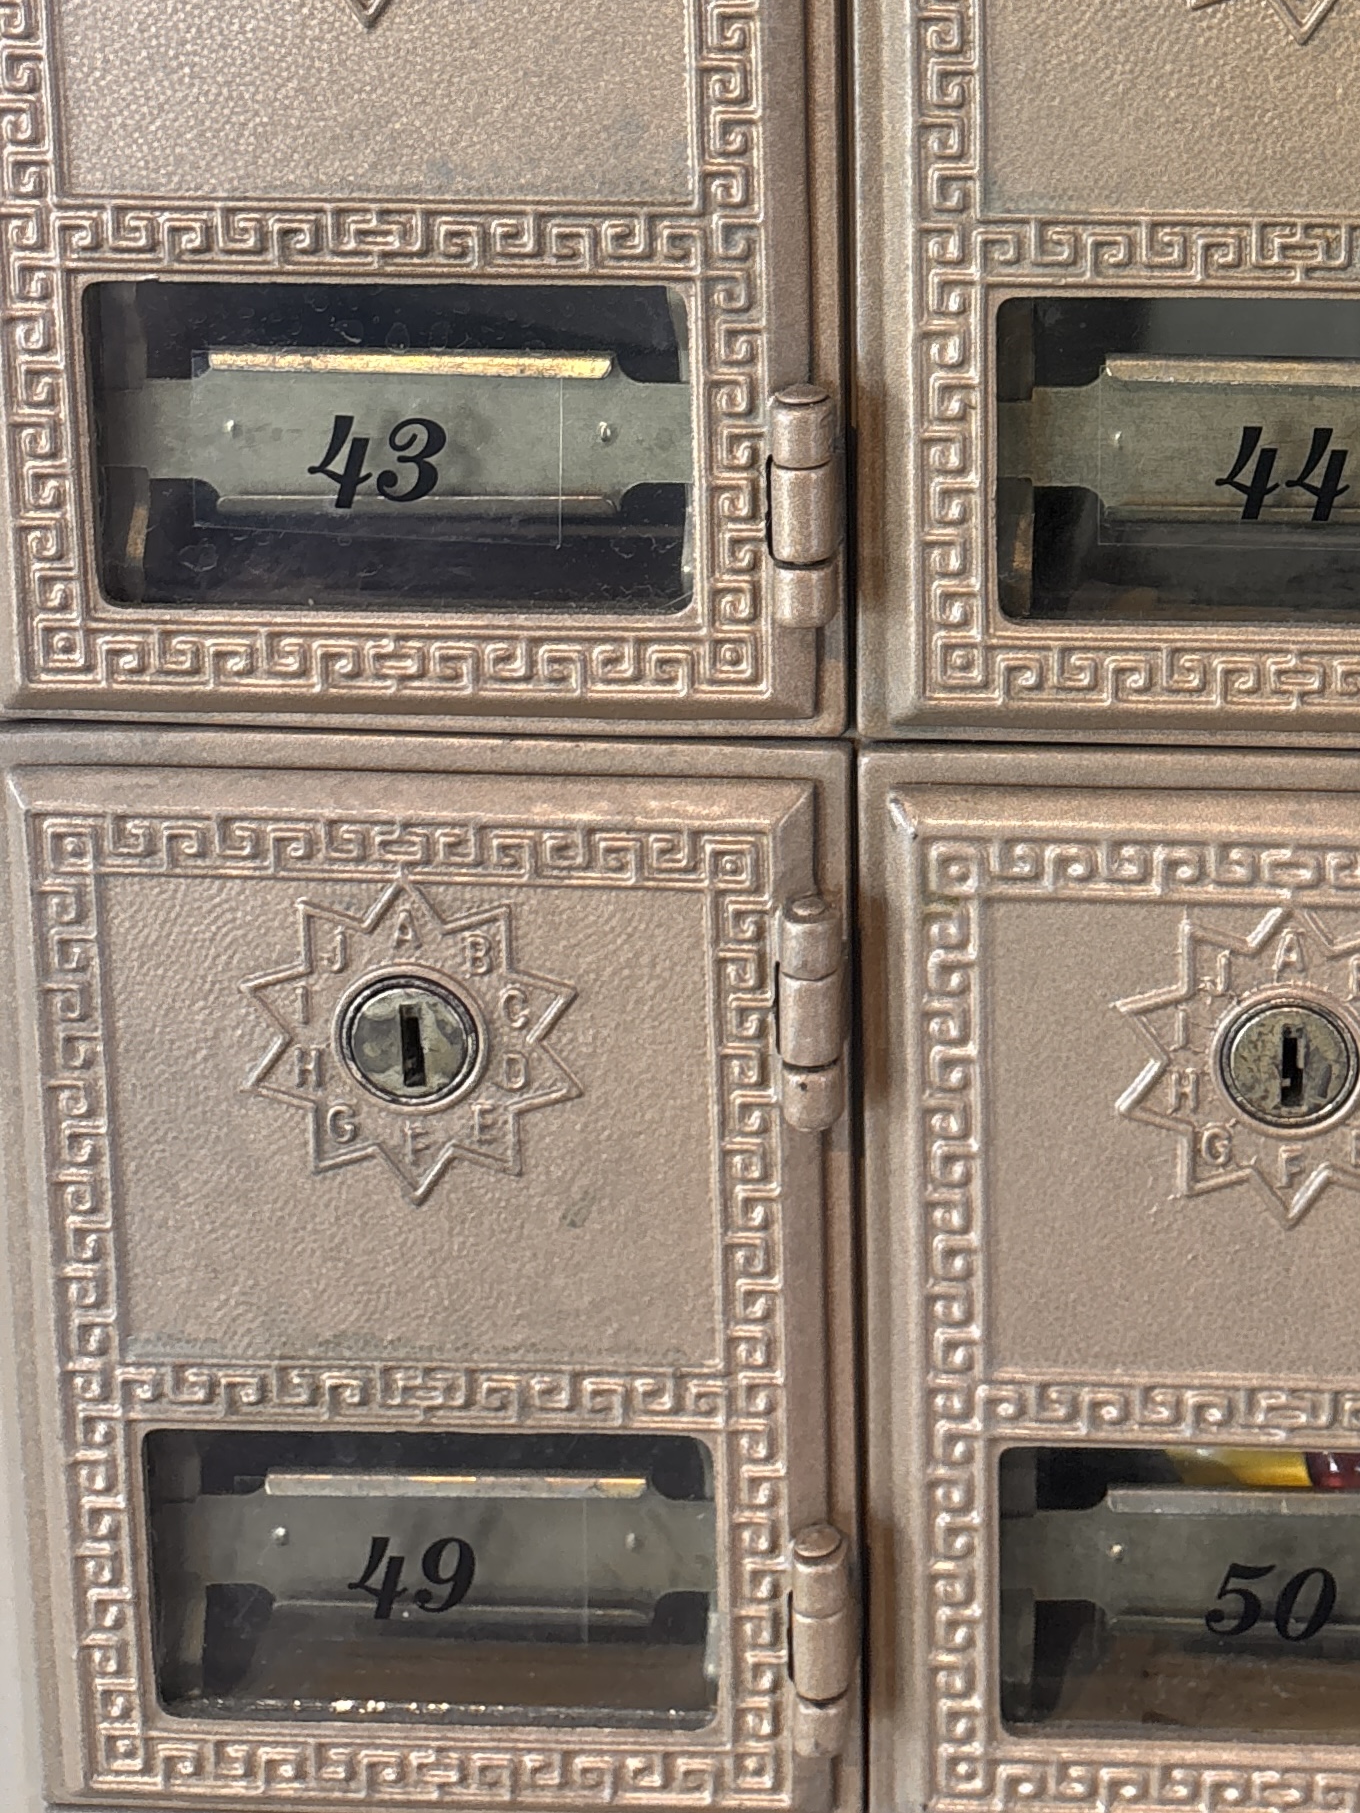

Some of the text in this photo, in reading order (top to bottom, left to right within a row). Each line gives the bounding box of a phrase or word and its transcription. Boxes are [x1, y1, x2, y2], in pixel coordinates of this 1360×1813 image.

[307, 414, 448, 510] 43
[1214, 425, 1351, 521] 44
[394, 908, 421, 950] A
[324, 928, 347, 973] J
[466, 933, 491, 976] B
[1273, 930, 1305, 973] A
[297, 986, 309, 1025] I
[502, 989, 529, 1028] C
[1175, 1006, 1188, 1050] I
[294, 1047, 321, 1089] H
[503, 1053, 529, 1091] D
[1169, 1070, 1197, 1113] H
[328, 1105, 357, 1143] G
[473, 1103, 495, 1143] E
[405, 1126, 430, 1163] F
[1202, 1124, 1231, 1165] G
[1279, 1146, 1304, 1188] F
[348, 1535, 476, 1620] 49
[1204, 1562, 1338, 1642] 50
